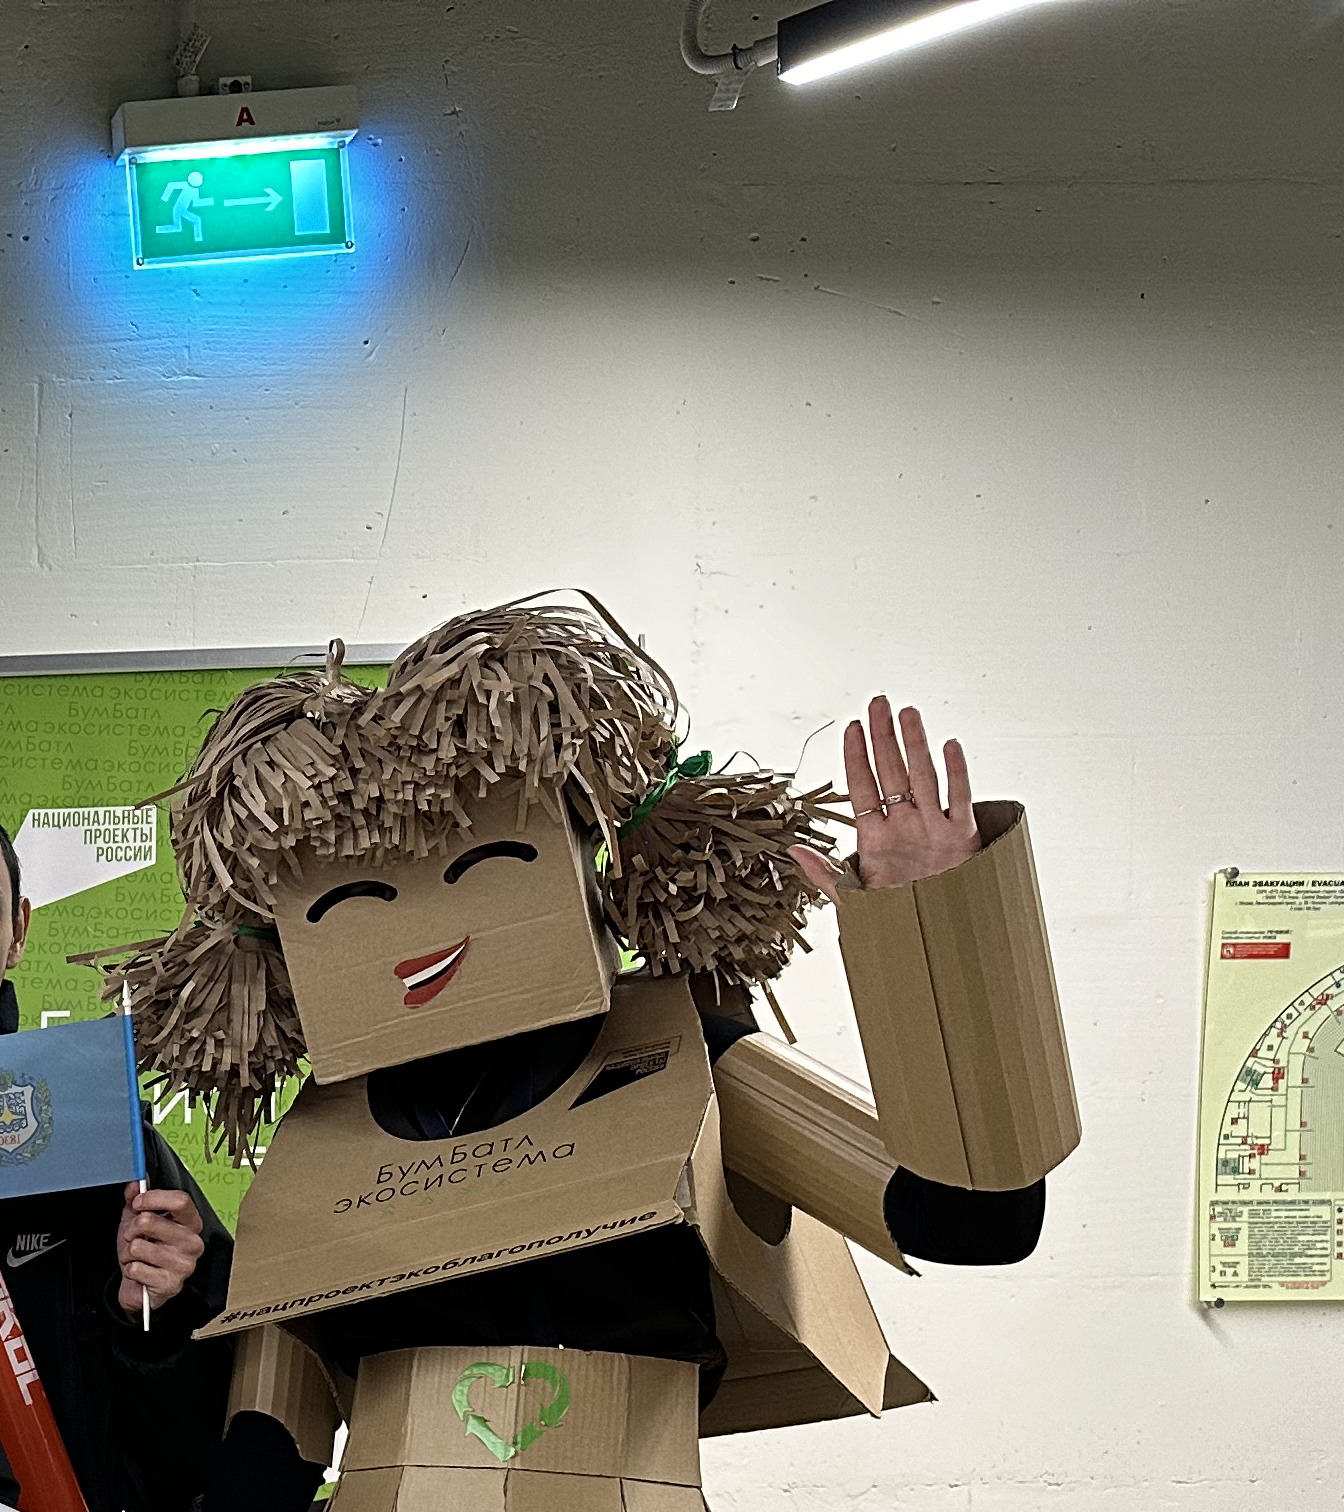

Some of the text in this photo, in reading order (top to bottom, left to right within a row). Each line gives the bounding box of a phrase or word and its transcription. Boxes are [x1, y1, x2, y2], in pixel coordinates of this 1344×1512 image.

[31, 808, 153, 829] НАЦИОНАЛЬНЫЕ
[83, 826, 153, 845] ПРОЕКТЫ
[96, 845, 153, 863] РОССИИ
[376, 1134, 536, 1185] БумБатл
[333, 1141, 577, 1215] экосистема
[15, 1232, 52, 1251] NIKE
[220, 1209, 658, 1325] #нацпроектэкоблагополучие
